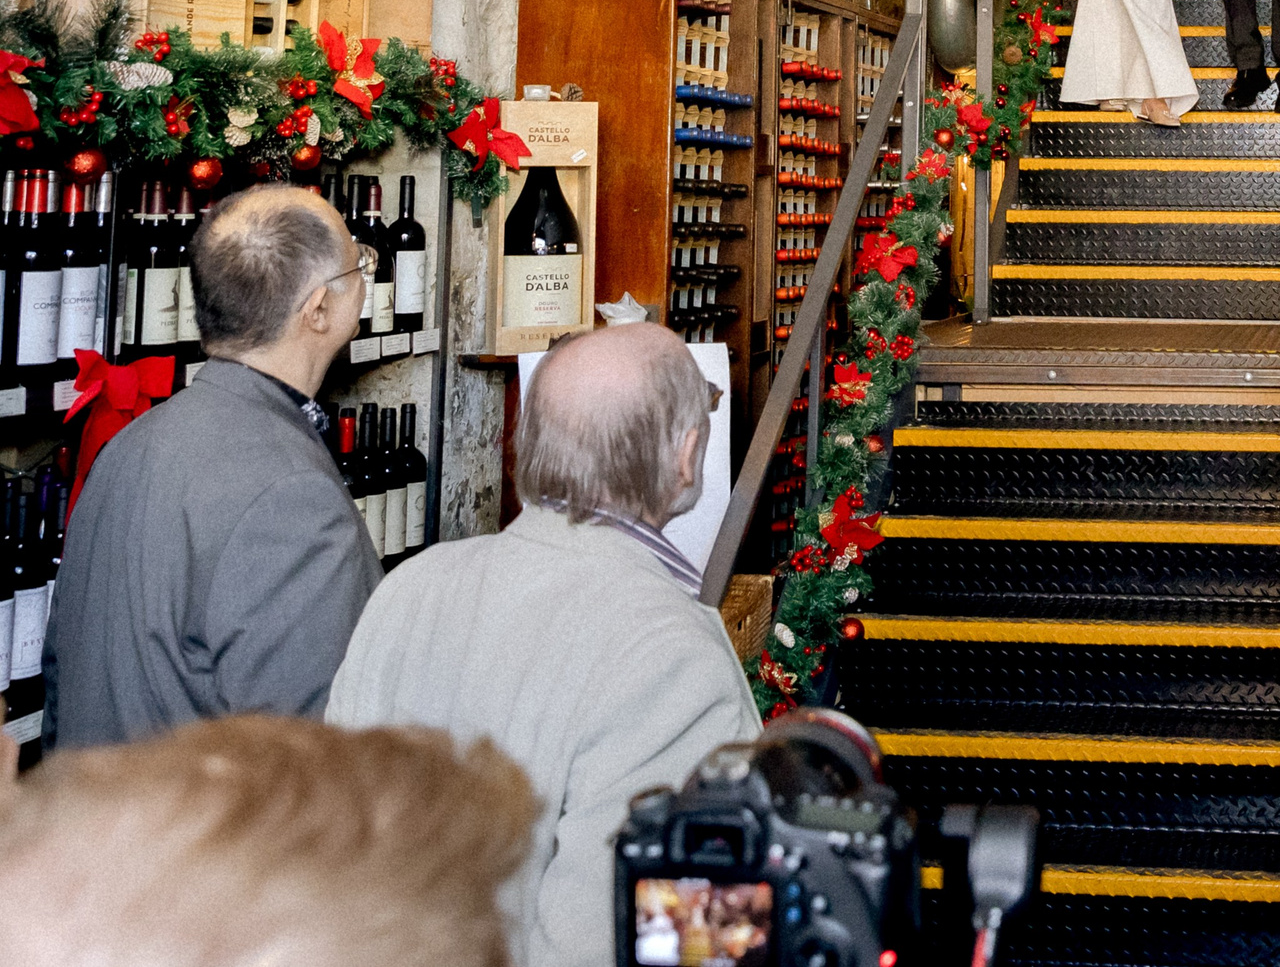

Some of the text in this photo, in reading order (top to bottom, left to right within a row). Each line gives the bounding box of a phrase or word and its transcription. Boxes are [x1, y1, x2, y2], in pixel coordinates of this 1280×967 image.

[528, 134, 570, 143] D'ALBA
[526, 273, 570, 281] CASTELLO
[525, 282, 569, 291] D'ALBA
[520, 332, 563, 340] RESER
